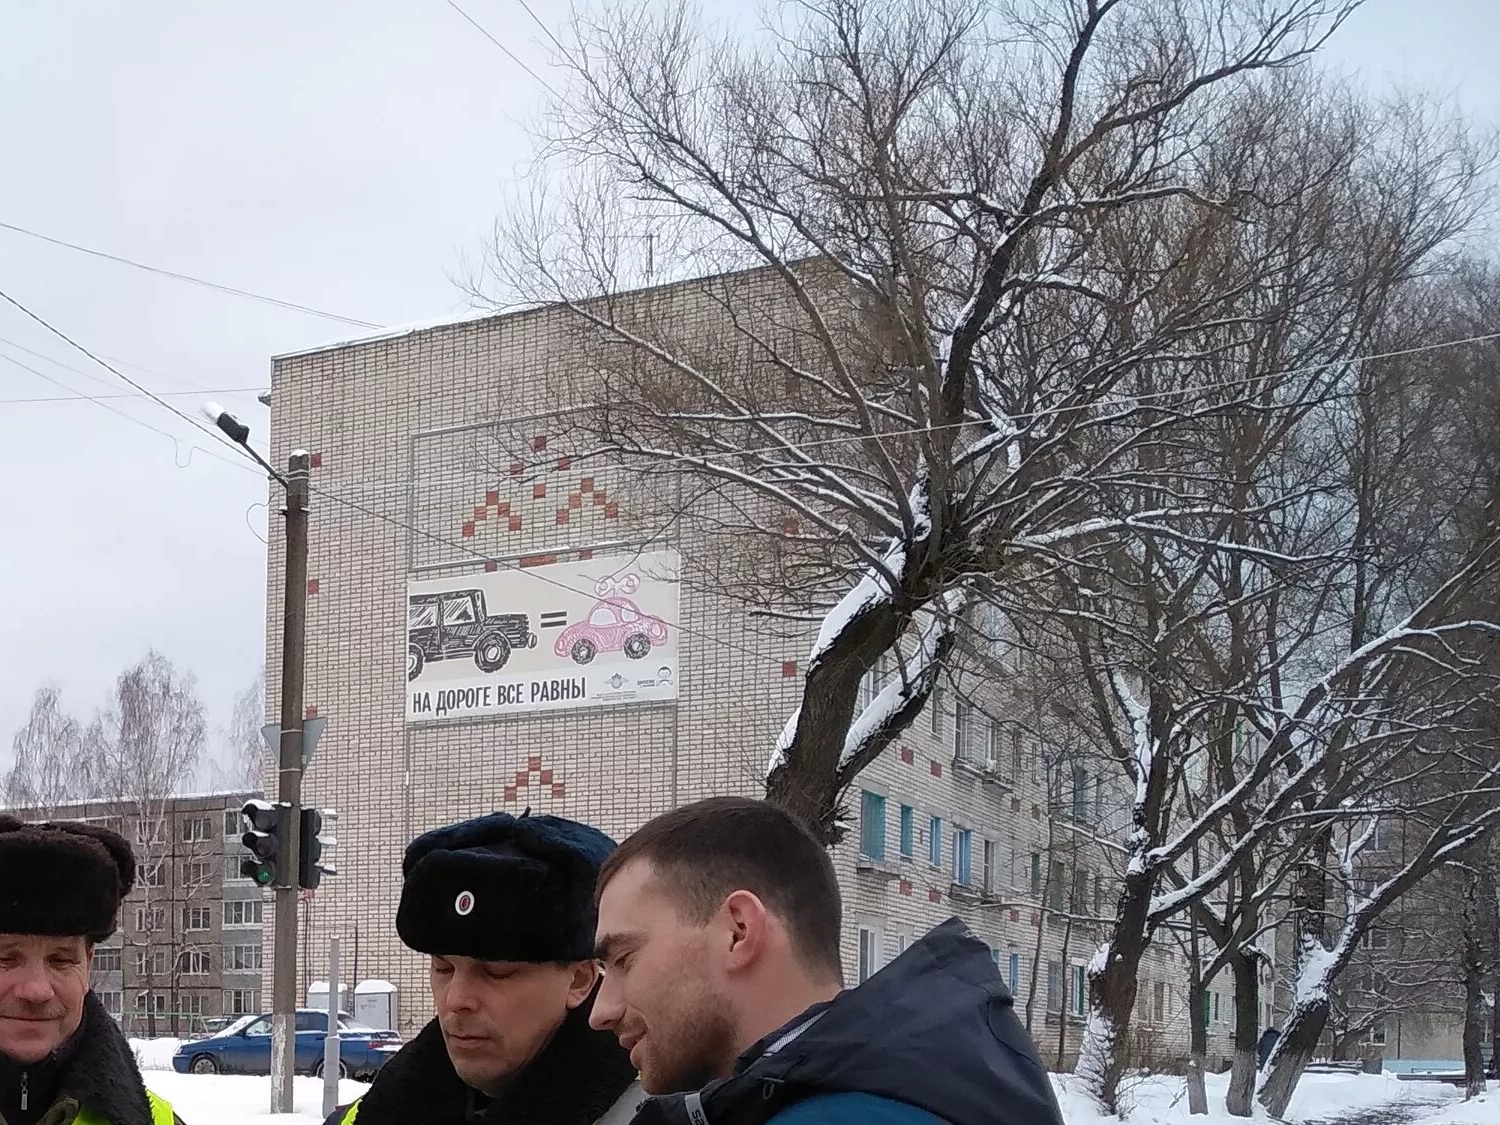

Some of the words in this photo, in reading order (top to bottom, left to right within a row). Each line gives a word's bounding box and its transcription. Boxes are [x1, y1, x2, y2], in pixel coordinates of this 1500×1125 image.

[412, 691, 432, 714] НА
[435, 686, 492, 717] ДОРОГЕ
[497, 682, 525, 706] ВСЕ
[530, 676, 586, 703] РАВНЫ
